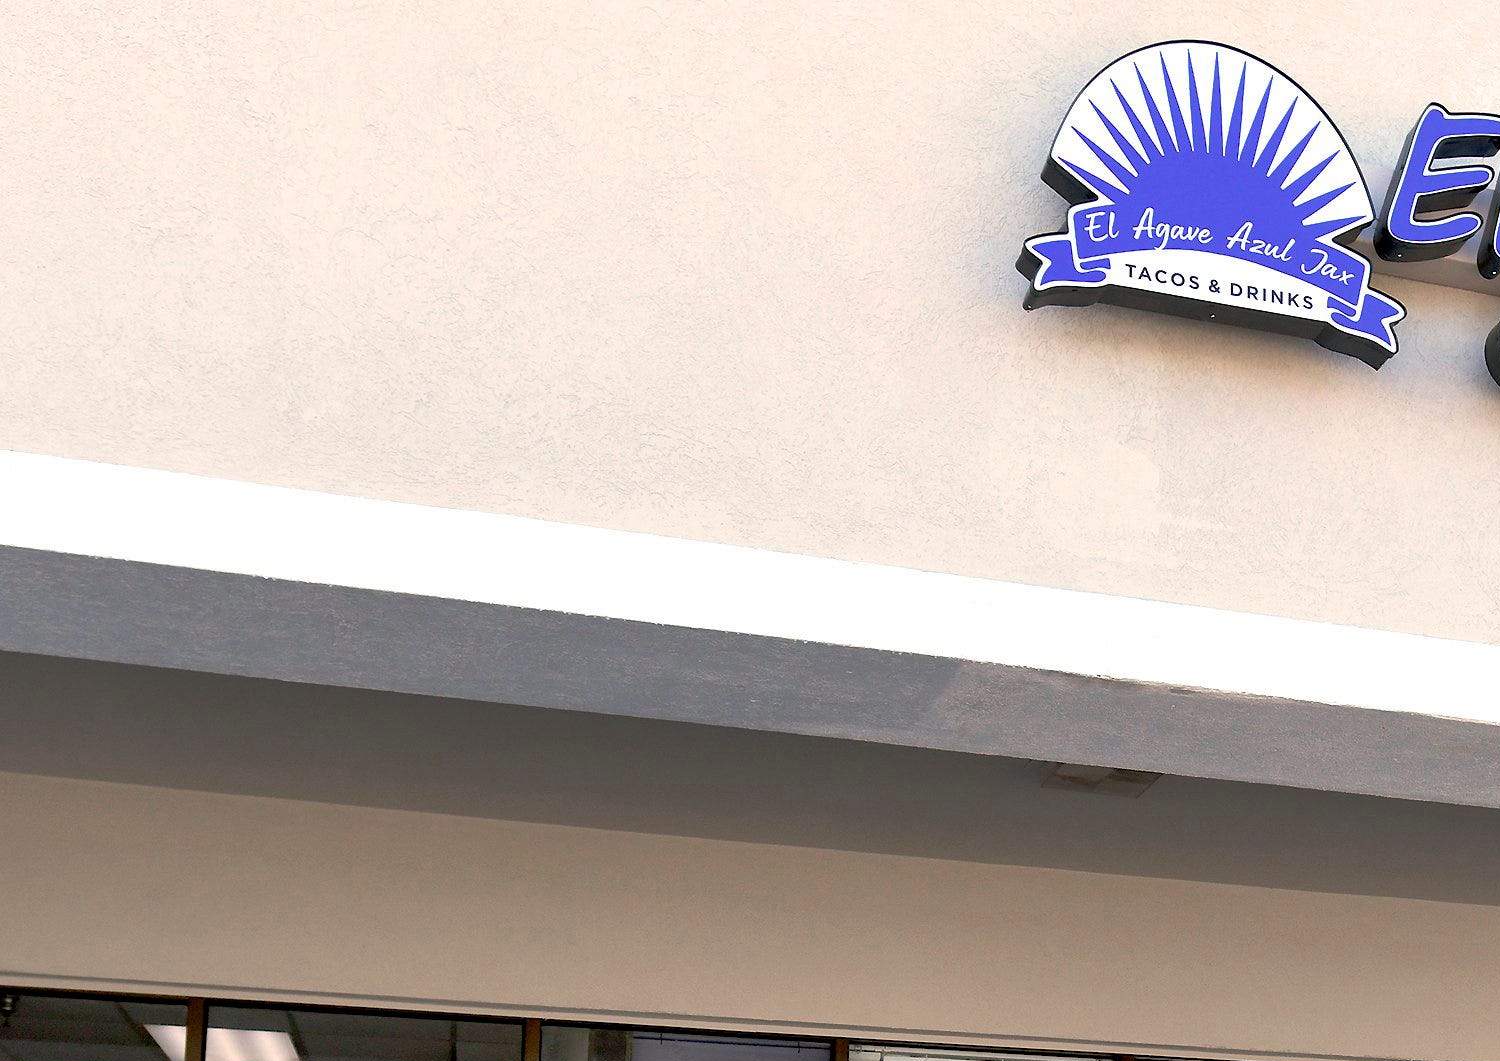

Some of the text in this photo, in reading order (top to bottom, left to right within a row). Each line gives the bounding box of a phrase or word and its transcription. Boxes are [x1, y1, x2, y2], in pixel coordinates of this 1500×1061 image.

[1084, 207, 1356, 286] El Agave Azul Jax
[1125, 263, 1315, 310] TACOS & DRINKS
